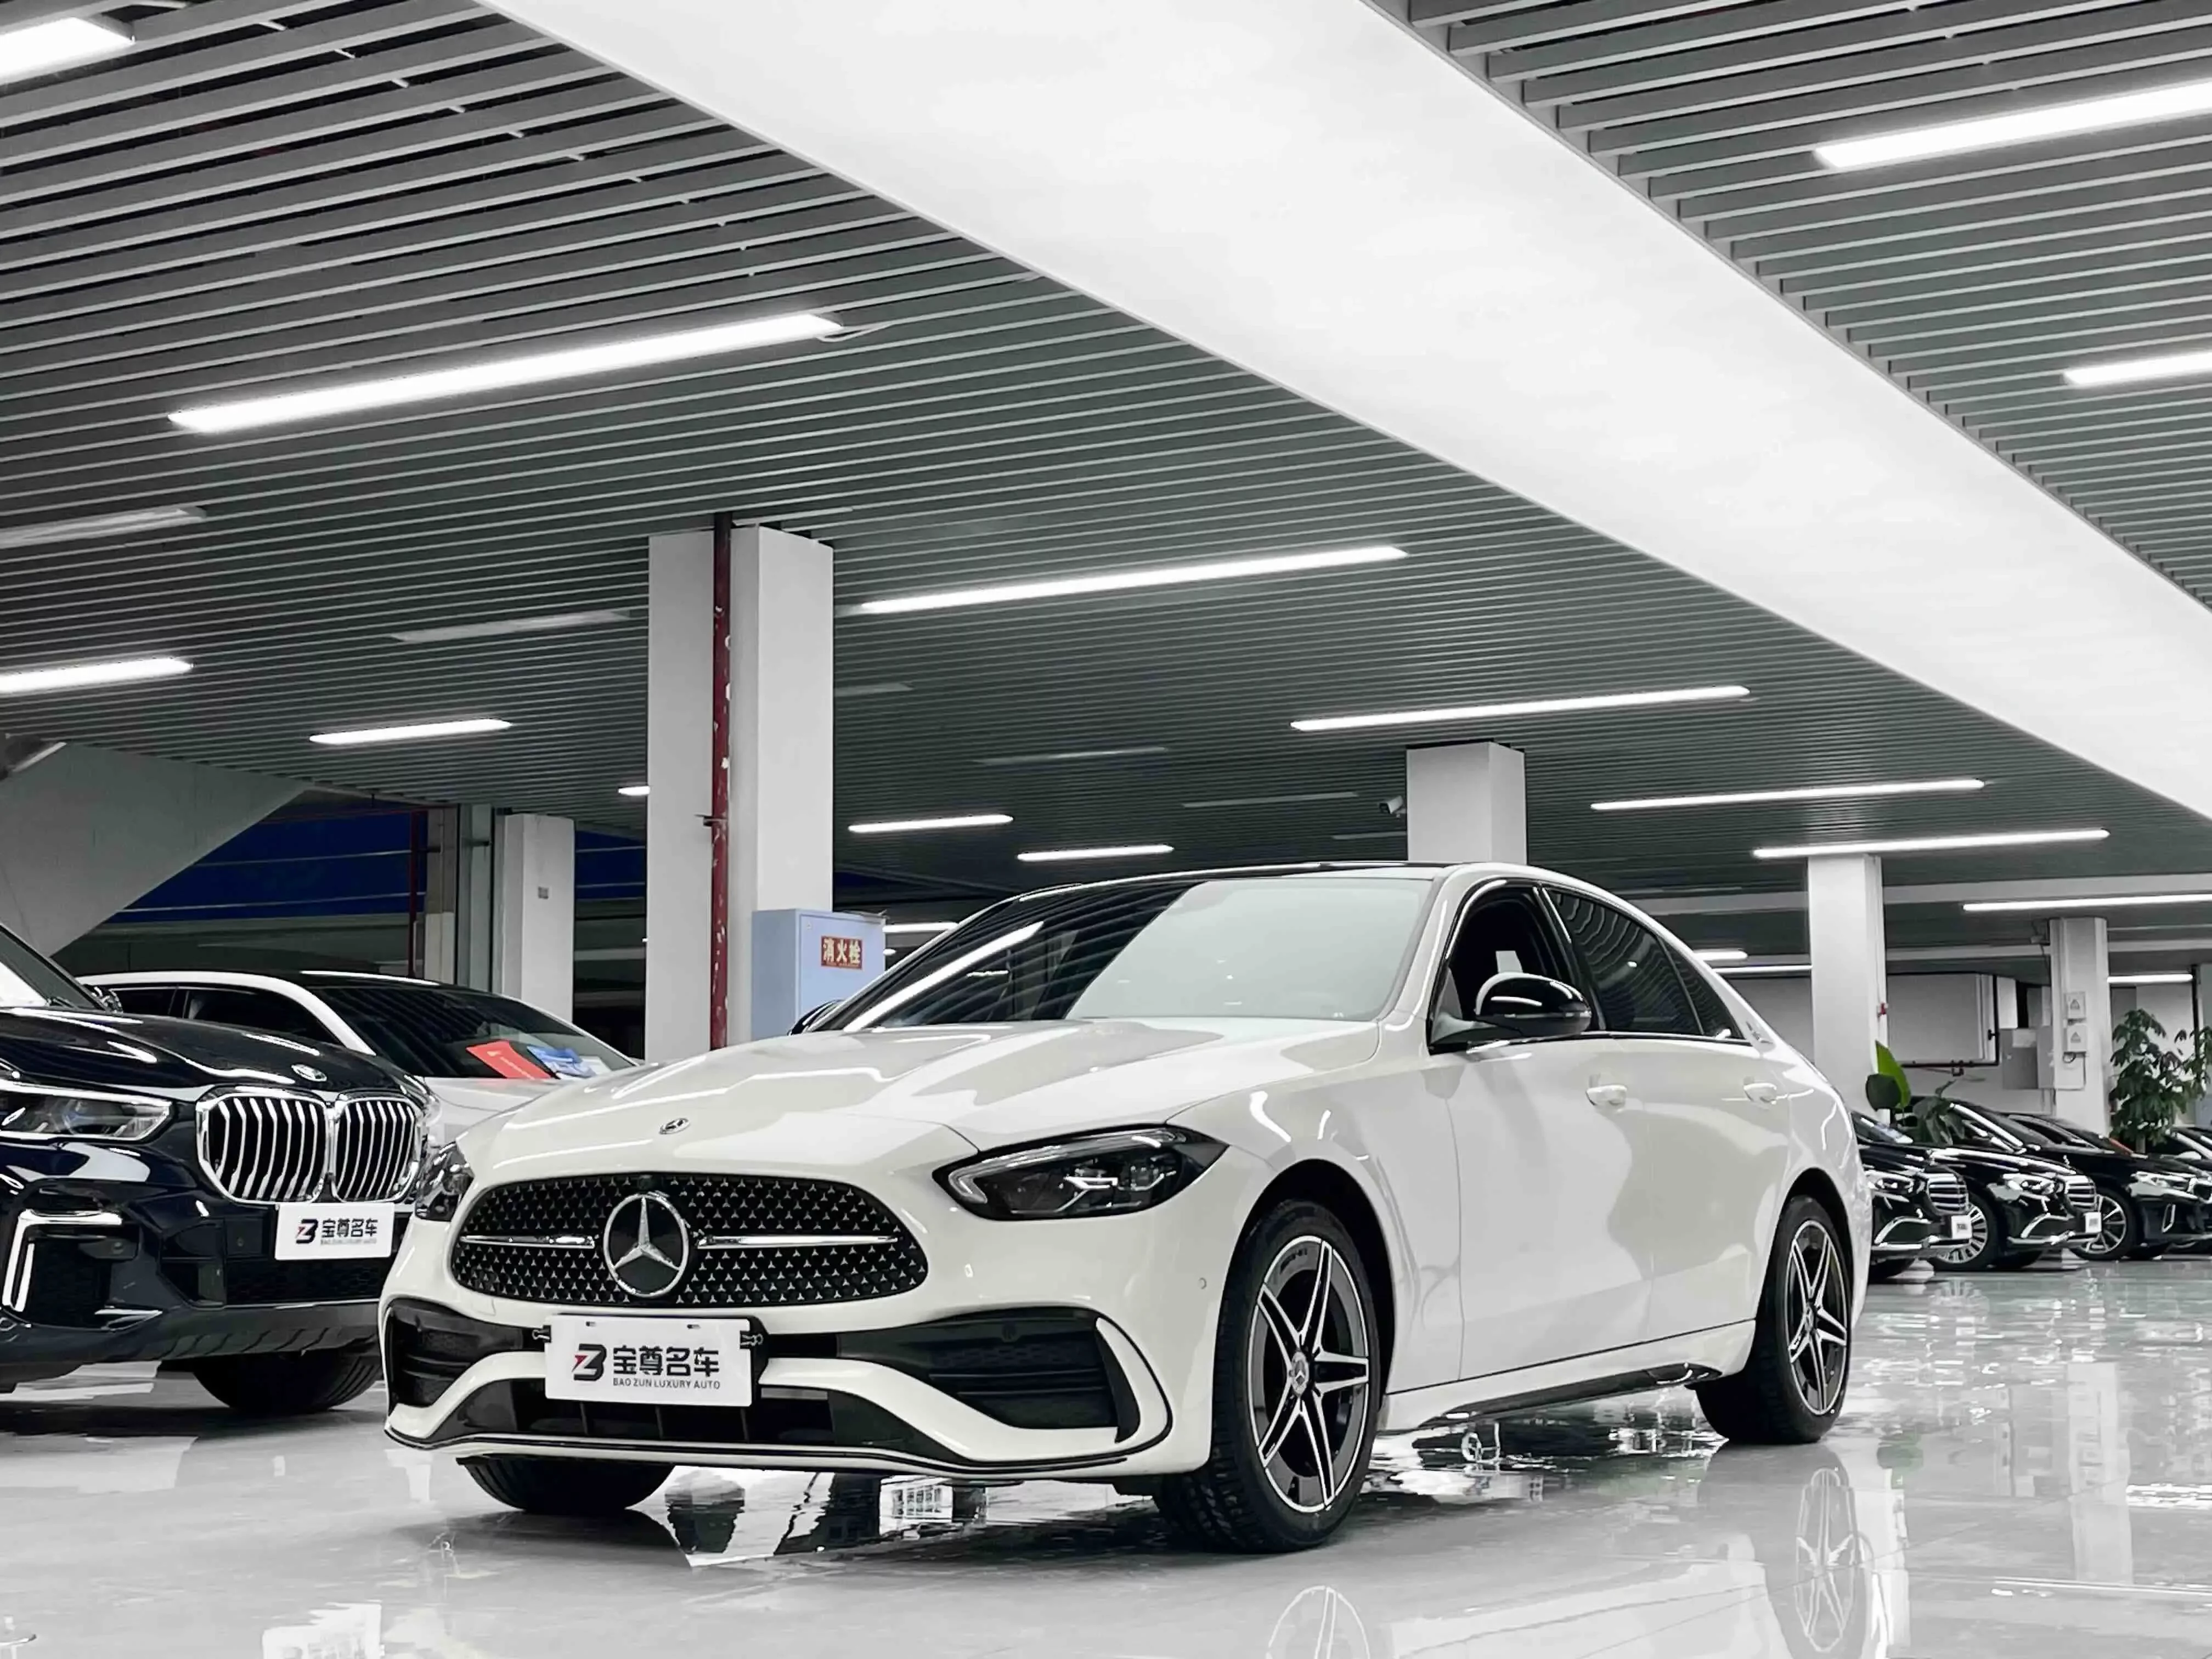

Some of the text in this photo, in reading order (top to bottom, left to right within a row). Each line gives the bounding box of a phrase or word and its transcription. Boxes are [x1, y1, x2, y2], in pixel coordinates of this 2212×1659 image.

[823, 938, 861, 964] 消火栓
[320, 1217, 378, 1238] 宝尊名车
[613, 1344, 720, 1378] 宝尊名车
[613, 1377, 721, 1390] BAO ZUN LUXURY AUTO
